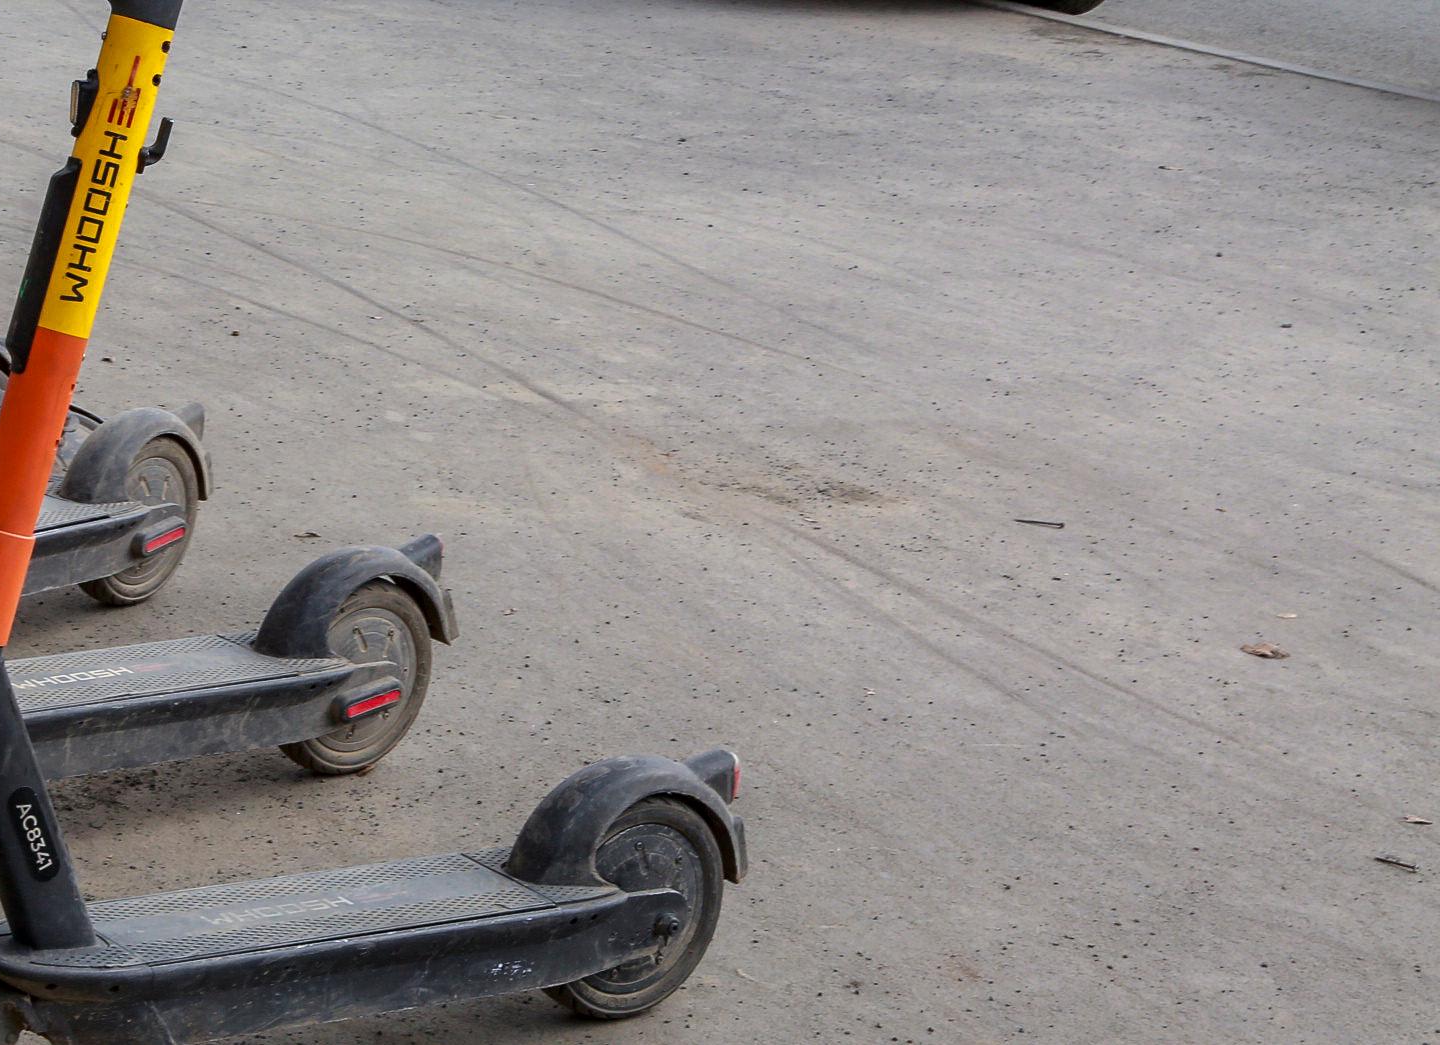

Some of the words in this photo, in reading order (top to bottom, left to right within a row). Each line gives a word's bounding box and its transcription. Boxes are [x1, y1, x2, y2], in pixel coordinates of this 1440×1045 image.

[60, 130, 128, 303] WHOOSH
[11, 666, 135, 690] WHOOSH
[16, 804, 53, 871] AC8341
[200, 896, 355, 926] WHOOSH
